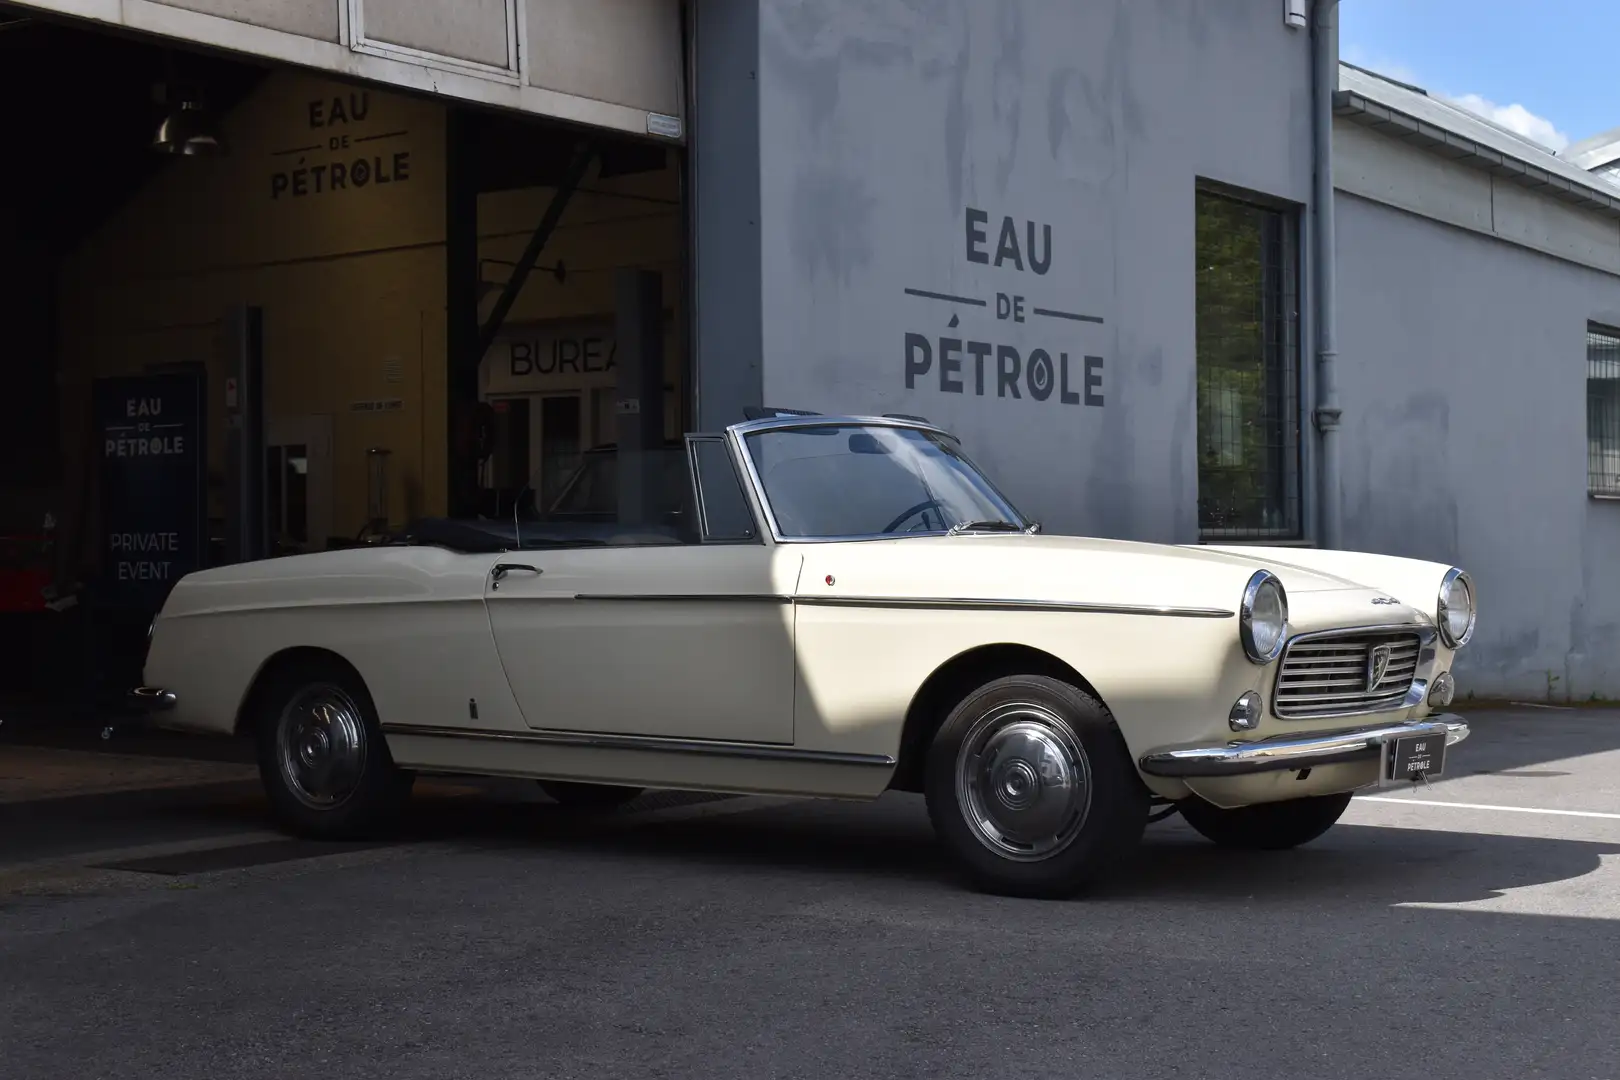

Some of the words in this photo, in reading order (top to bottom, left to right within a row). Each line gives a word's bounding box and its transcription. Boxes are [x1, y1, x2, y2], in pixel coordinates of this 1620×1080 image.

[309, 92, 368, 129] EAU
[329, 135, 350, 151] DE
[271, 152, 409, 199] PÉTROLE
[966, 207, 1052, 275] EAU
[996, 292, 1025, 323] DE
[904, 313, 1104, 407] PÉTROLE
[126, 397, 162, 417] EAU
[105, 432, 184, 458] PÉTROLE
[110, 532, 179, 552] PRIVATE
[118, 561, 172, 580] EVENT
[1415, 742, 1427, 752] EAU
